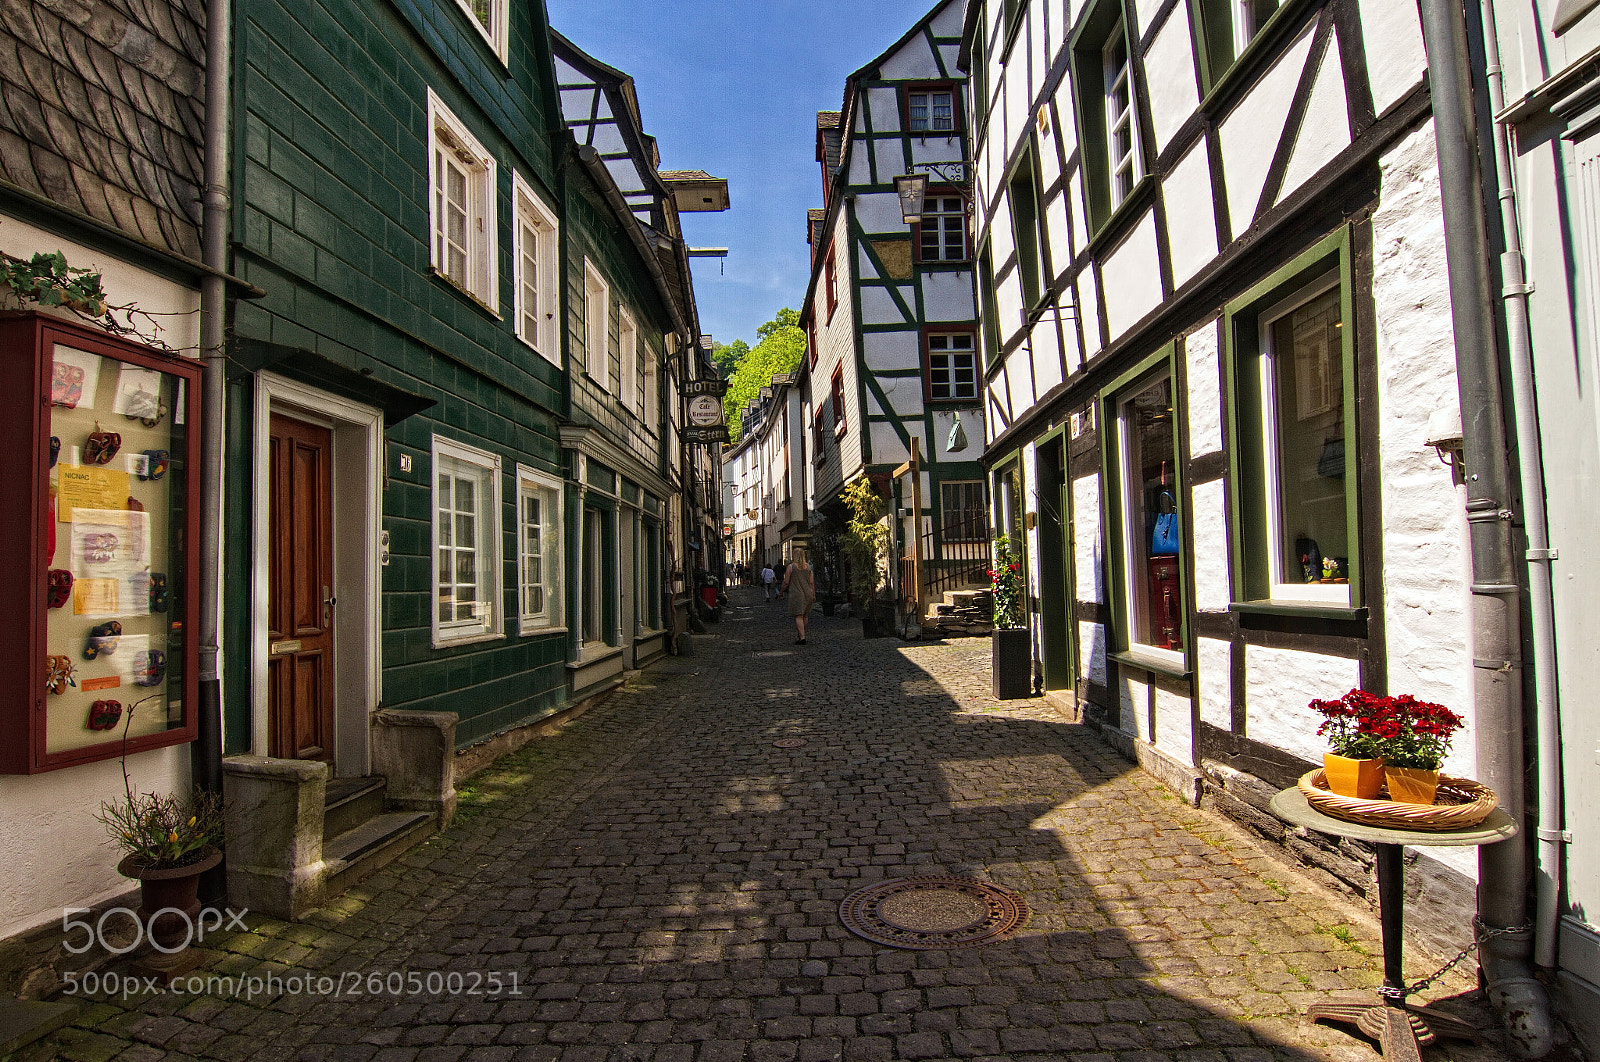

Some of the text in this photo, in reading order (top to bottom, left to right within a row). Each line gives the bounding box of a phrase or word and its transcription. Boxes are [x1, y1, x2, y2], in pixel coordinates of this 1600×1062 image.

[685, 381, 723, 393] HOTEL
[698, 429, 726, 440] Stern
[64, 472, 90, 481] NICNAC
